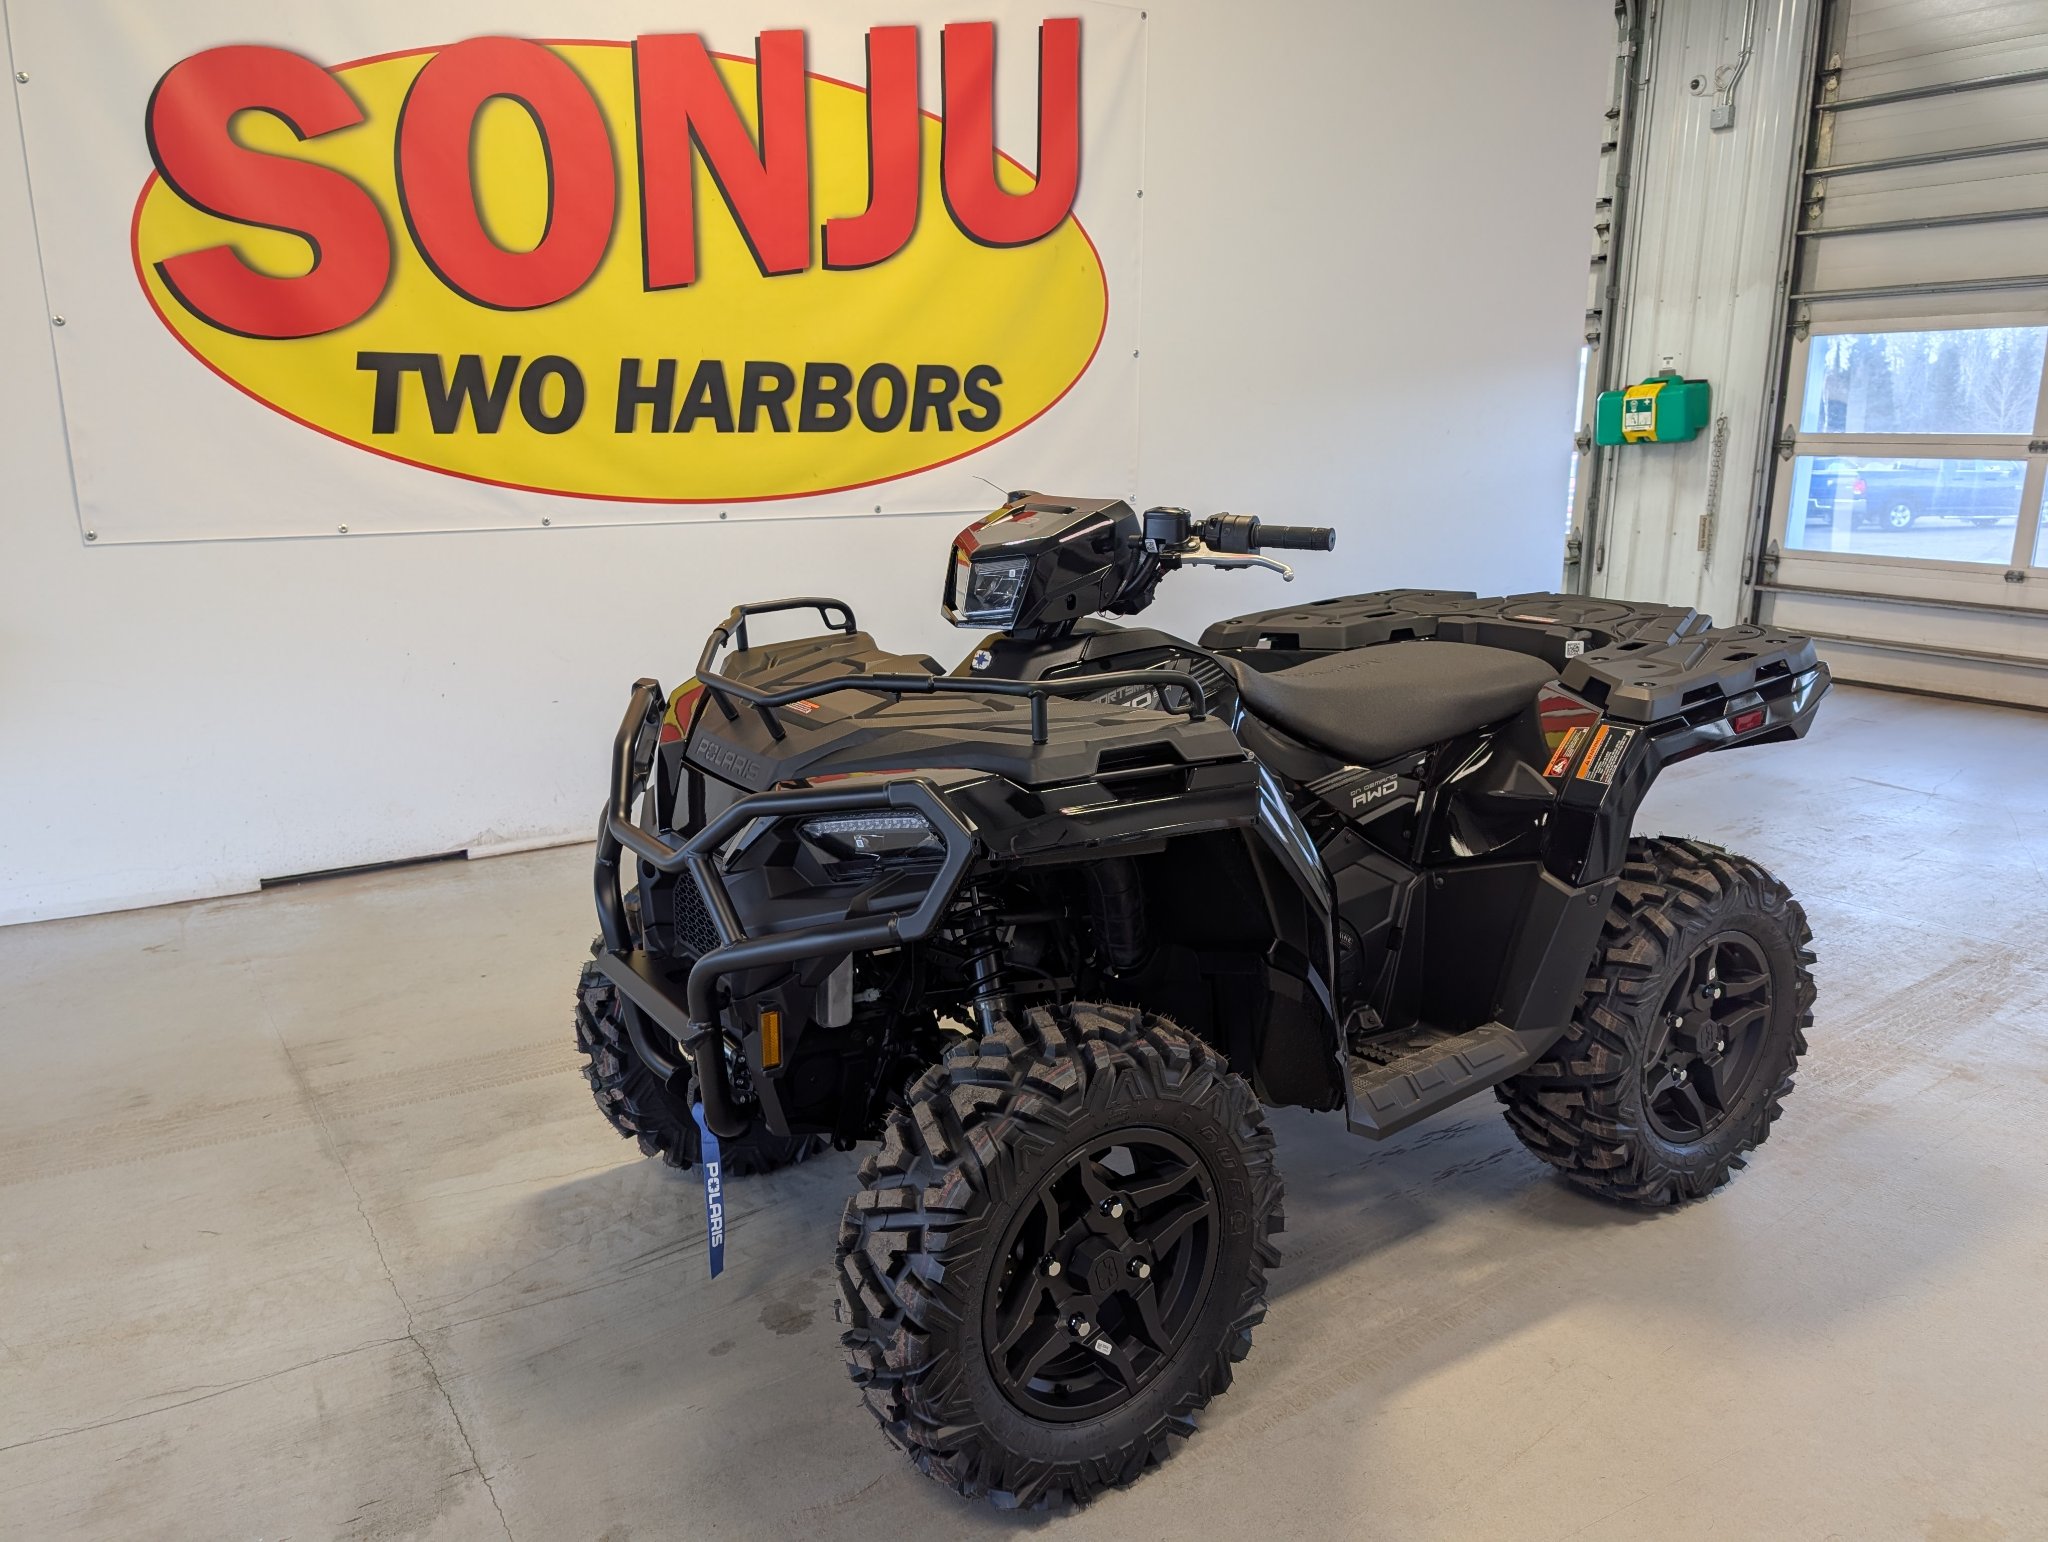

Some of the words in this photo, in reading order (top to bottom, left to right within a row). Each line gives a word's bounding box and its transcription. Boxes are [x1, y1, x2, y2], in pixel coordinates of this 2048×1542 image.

[147, 17, 1081, 338] SONJU
[356, 350, 585, 435] TWO
[614, 357, 1002, 434] HARBORS
[697, 738, 760, 780] POLARIS
[1363, 773, 1398, 791] DEMAND
[1352, 780, 1398, 809] AWD
[707, 1162, 723, 1248] POLARIS
